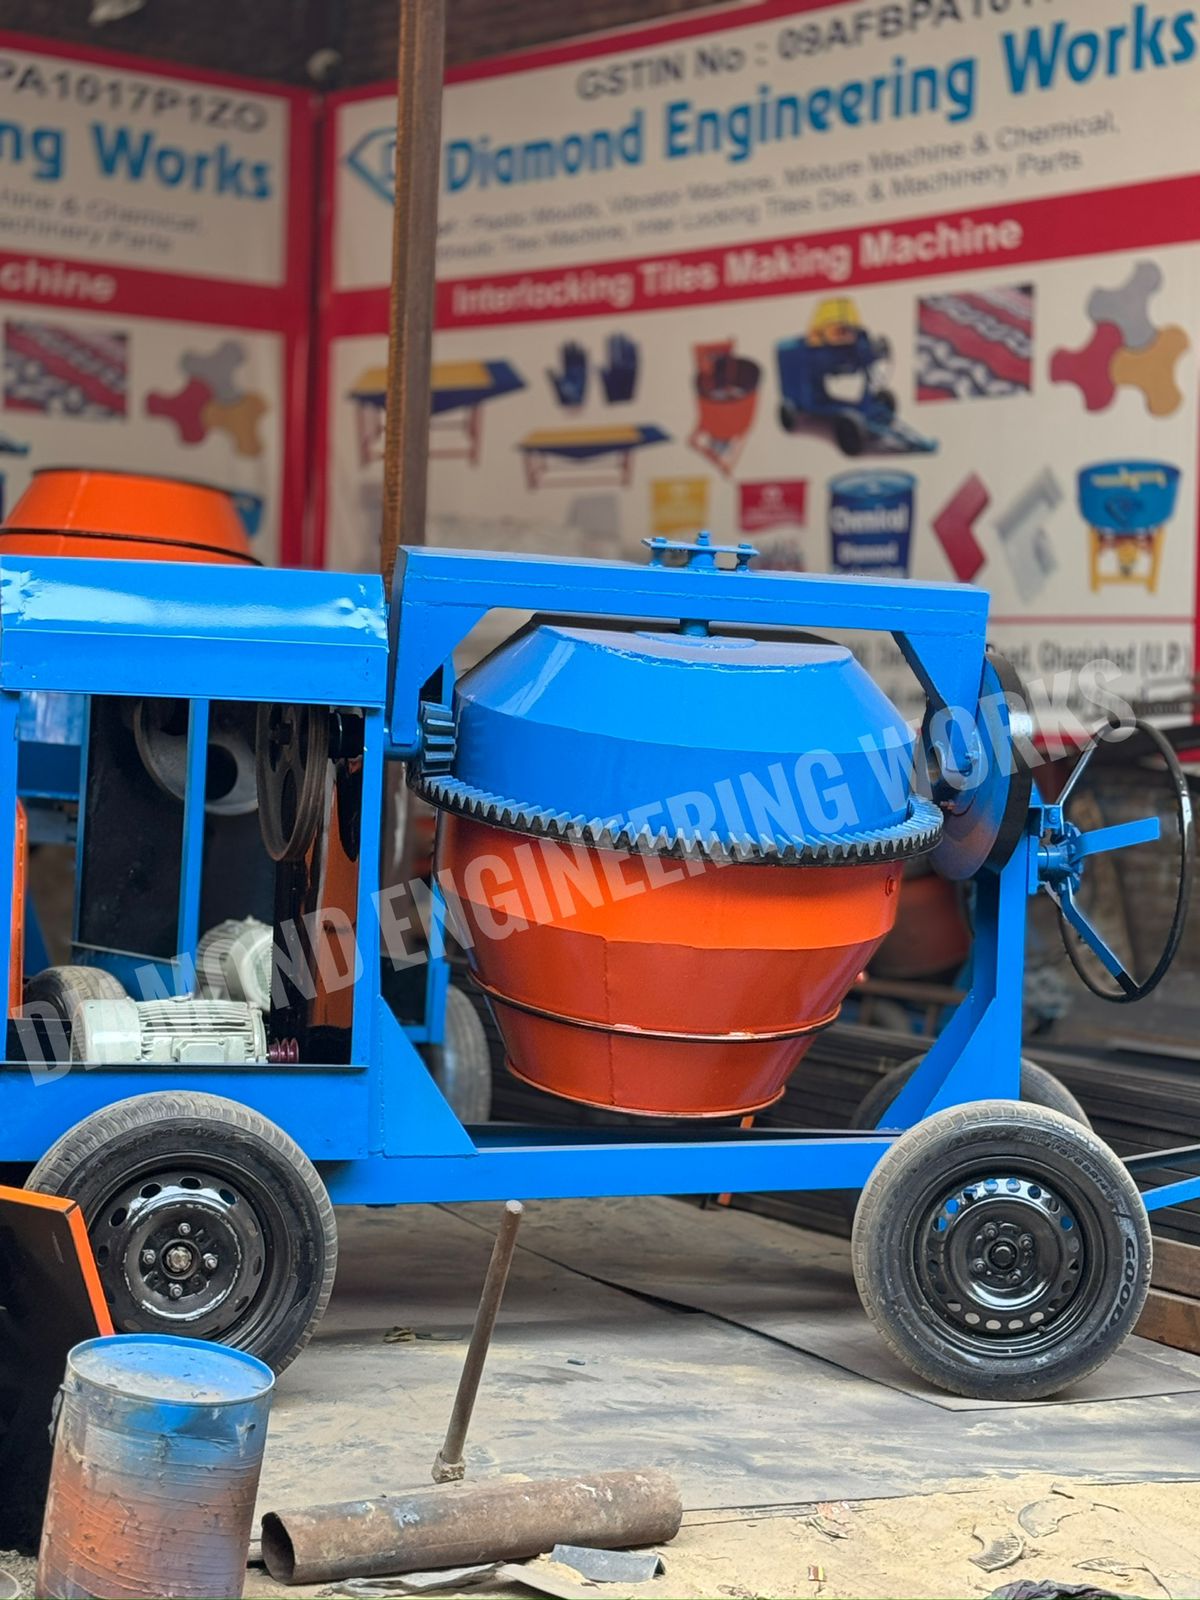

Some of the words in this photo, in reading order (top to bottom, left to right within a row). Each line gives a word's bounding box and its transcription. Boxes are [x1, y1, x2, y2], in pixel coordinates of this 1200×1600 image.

[444, 106, 646, 194] Diamond
[663, 55, 979, 165] Engineering
[1000, 3, 1198, 95] Works
[577, 50, 683, 101] GSTIN
[694, 45, 746, 78] No
[90, 119, 273, 200] Works
[451, 270, 635, 316] Interlocking
[638, 251, 719, 294] Tiles
[722, 241, 853, 288] Making
[858, 218, 1024, 271] Machine
